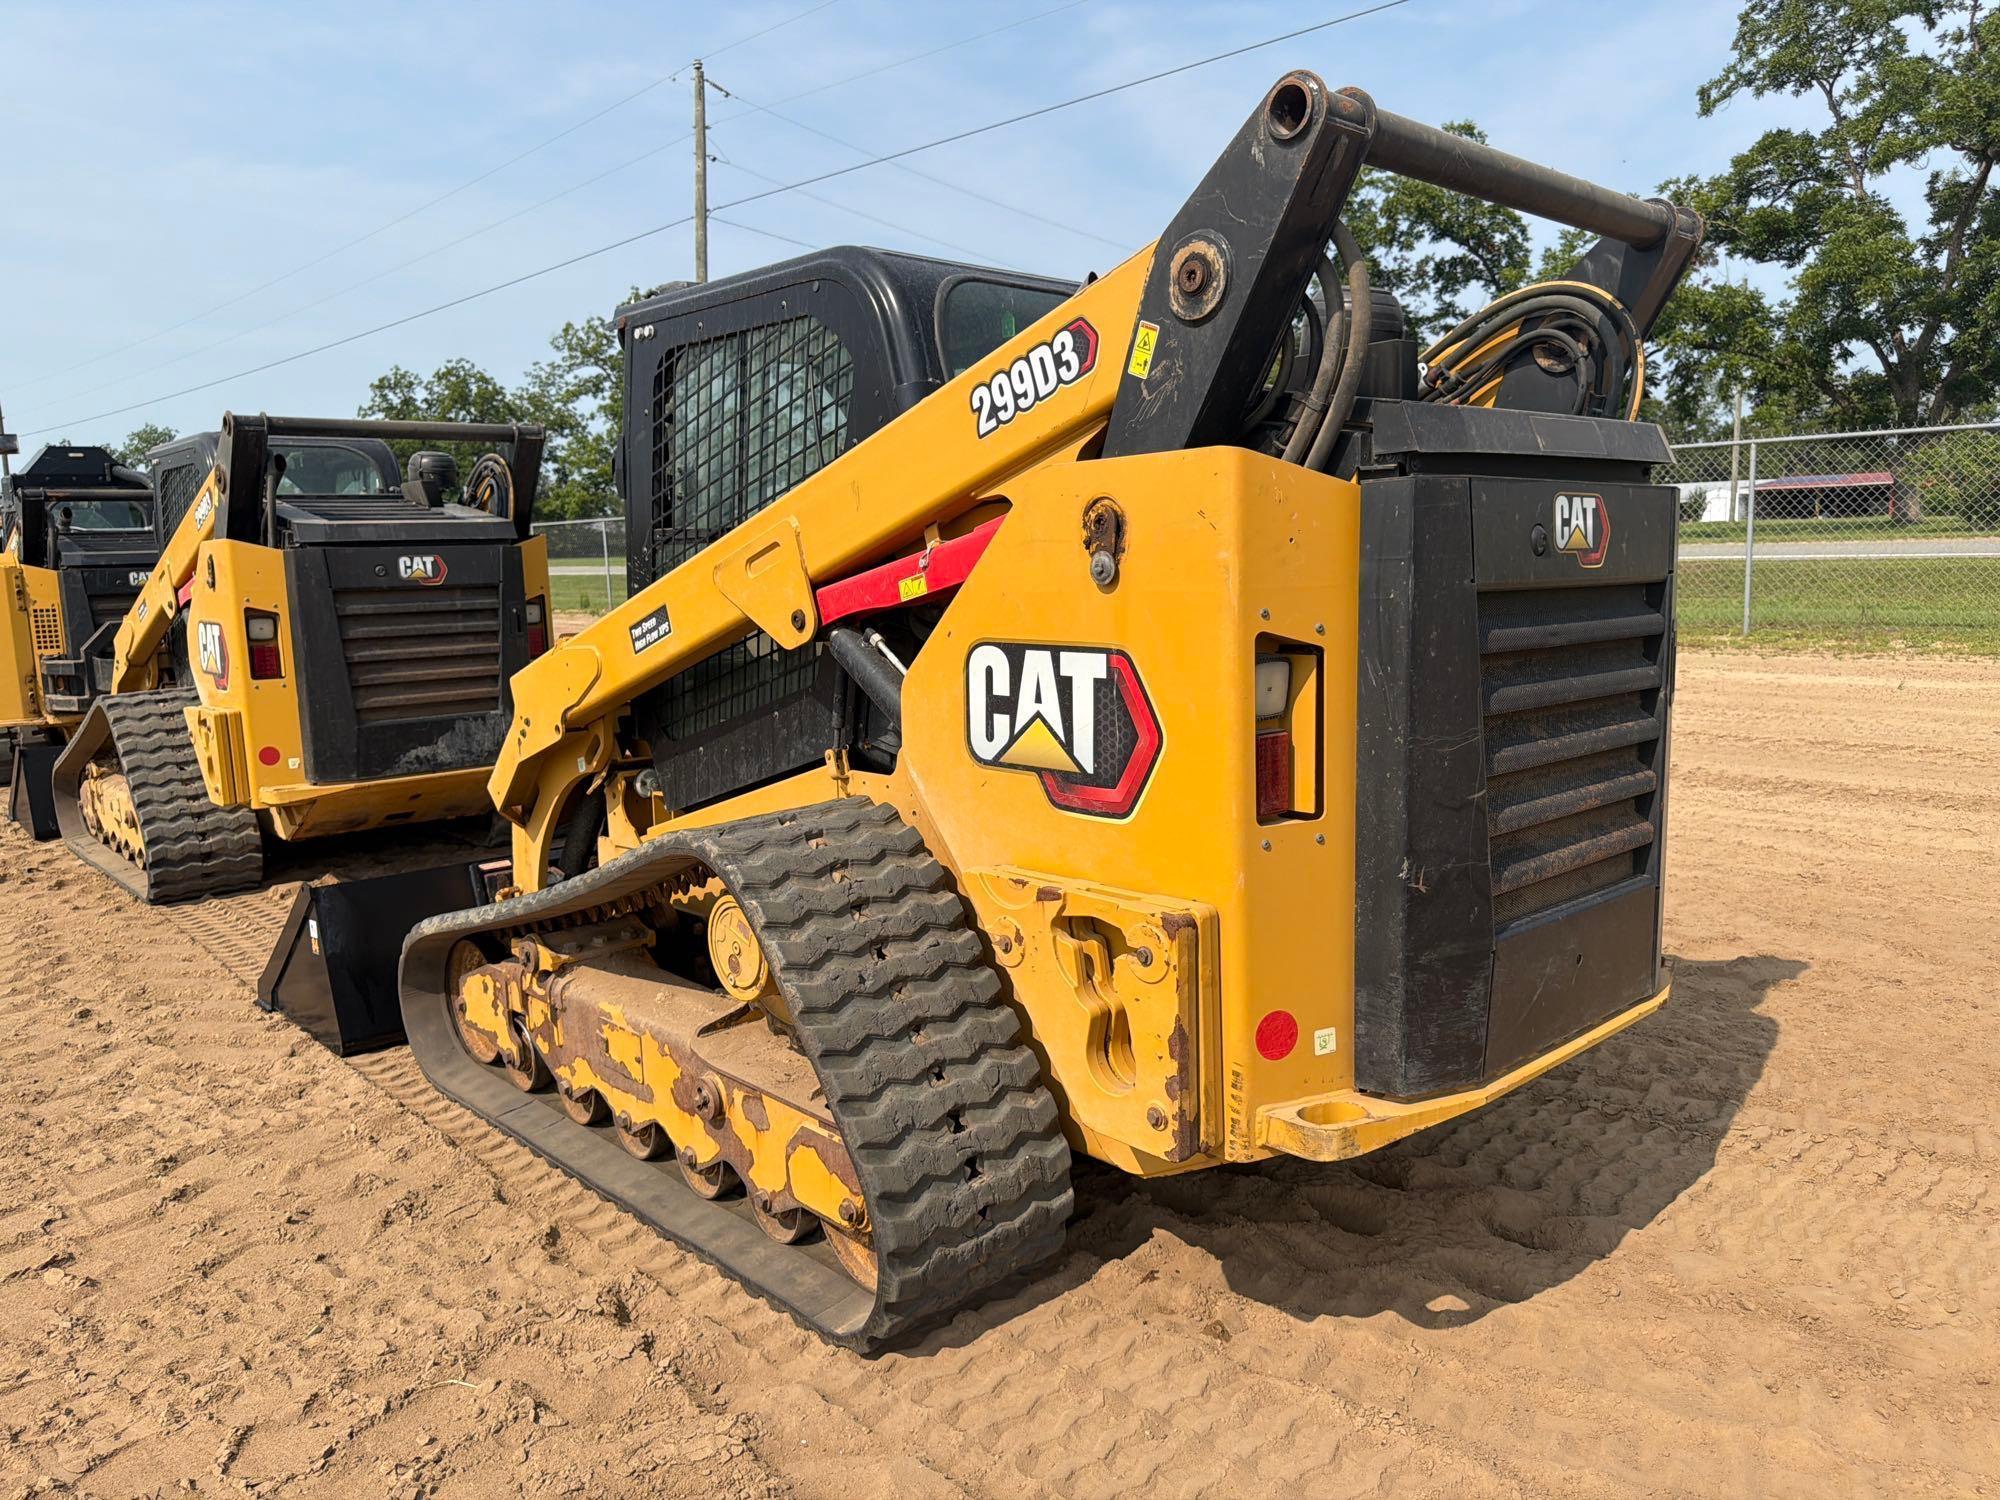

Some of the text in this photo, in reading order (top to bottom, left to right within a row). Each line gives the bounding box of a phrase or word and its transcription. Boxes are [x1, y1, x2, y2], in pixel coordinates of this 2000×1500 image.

[971, 330, 1080, 436] 299D3
[1555, 495, 1596, 549] CAT
[399, 556, 435, 578] CAT
[198, 622, 221, 674] CAT
[968, 645, 1107, 774] CAT
